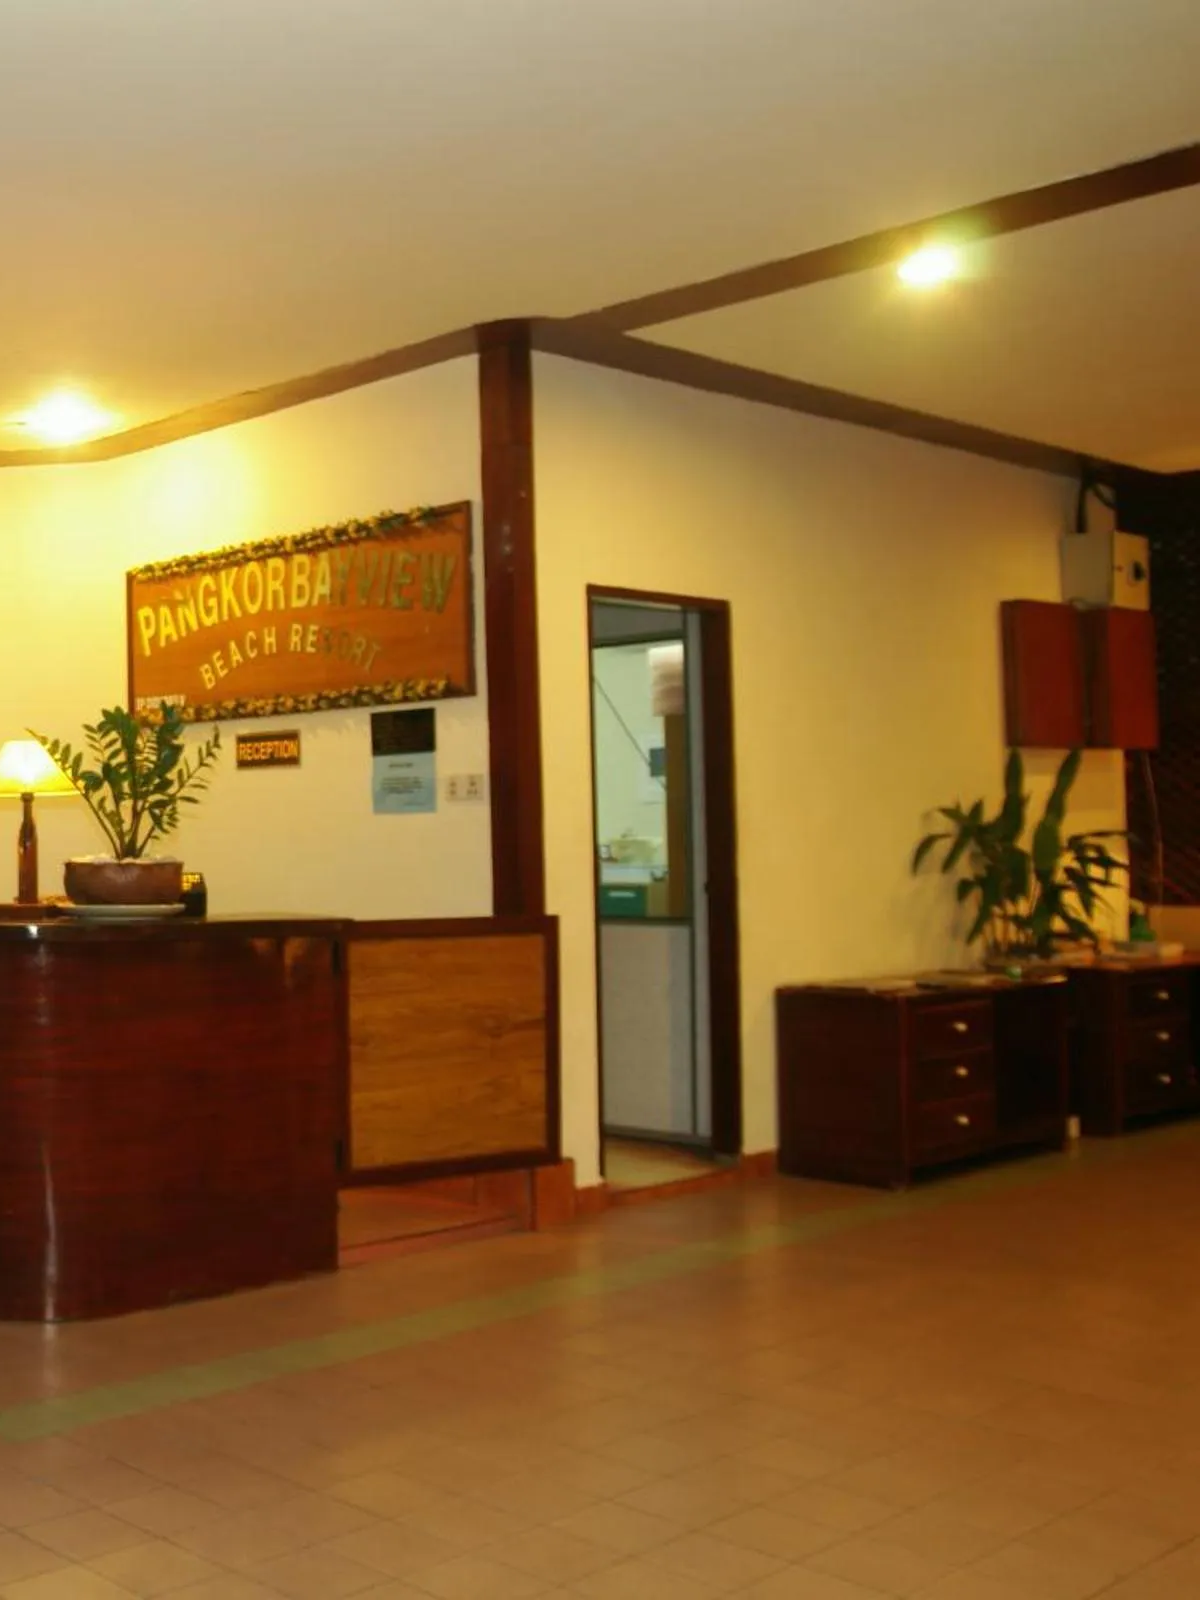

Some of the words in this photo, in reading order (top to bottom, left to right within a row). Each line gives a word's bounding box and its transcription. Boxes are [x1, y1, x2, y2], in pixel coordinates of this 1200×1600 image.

[201, 626, 277, 689] BEACH
[290, 624, 381, 672] RESORT
[239, 739, 297, 760] RECEPTION
